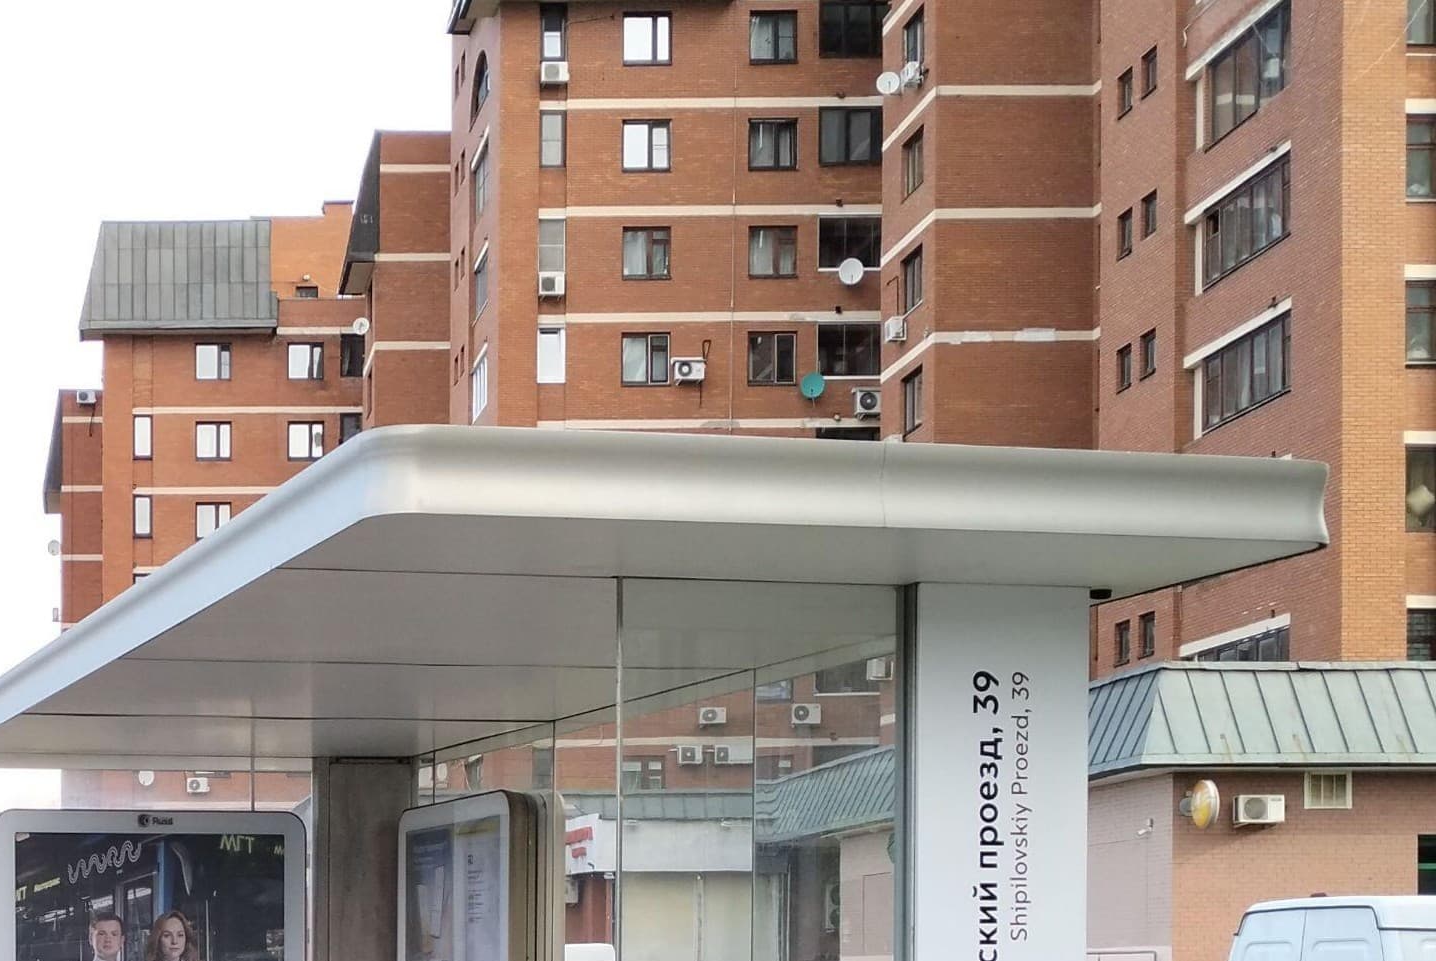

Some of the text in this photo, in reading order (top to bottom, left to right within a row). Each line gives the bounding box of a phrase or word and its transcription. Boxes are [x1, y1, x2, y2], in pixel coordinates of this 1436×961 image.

[972, 670, 1000, 715] 39
[979, 726, 1005, 869] проезд,
[1009, 671, 1033, 941] Shipilovskiy Proezd, 39
